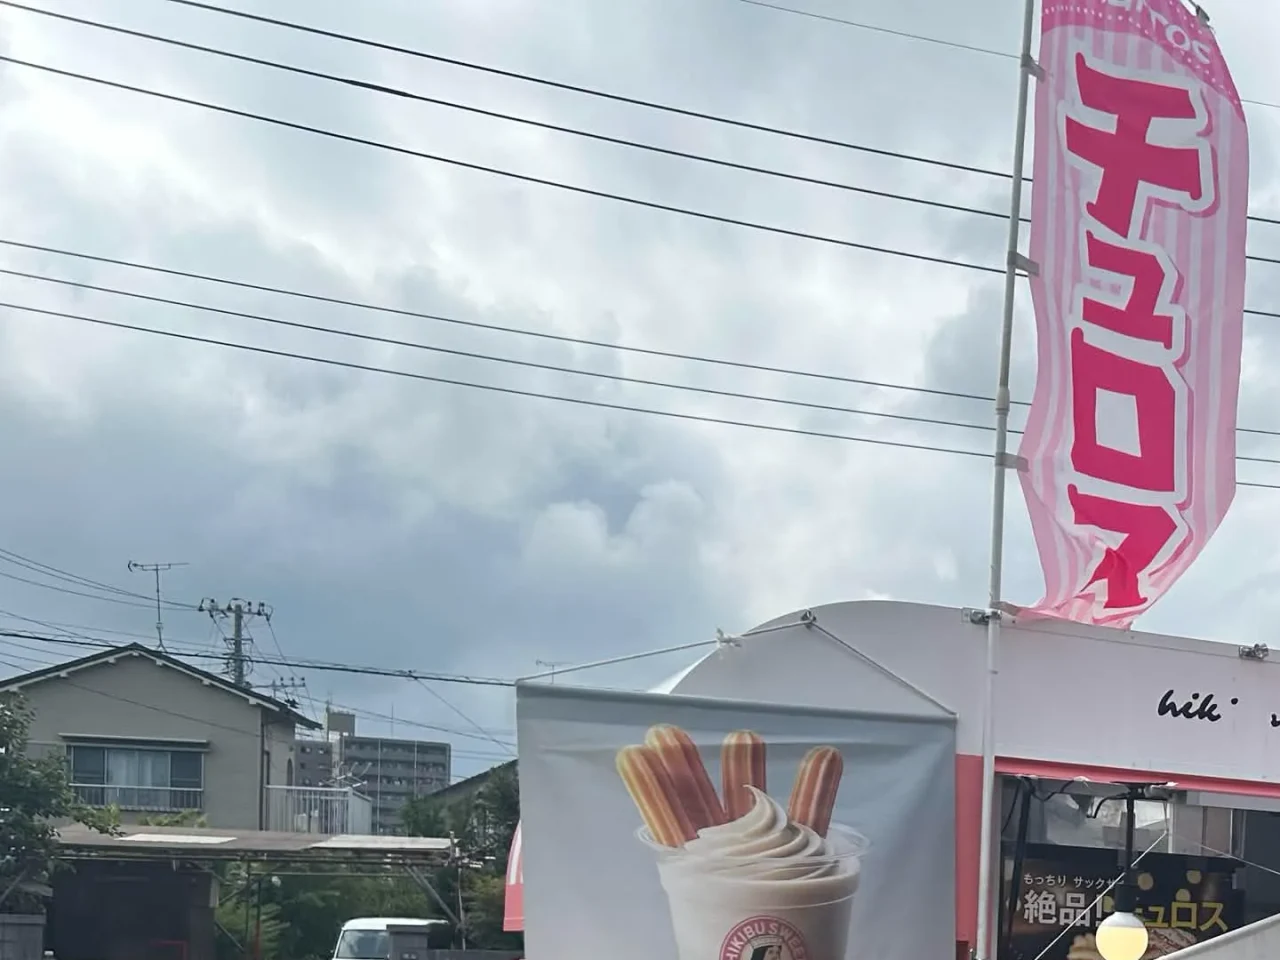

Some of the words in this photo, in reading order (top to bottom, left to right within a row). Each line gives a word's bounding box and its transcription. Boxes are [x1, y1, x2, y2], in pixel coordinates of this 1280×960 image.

[1065, 51, 1202, 609] チュロス
[1024, 873, 1067, 888] もっちり
